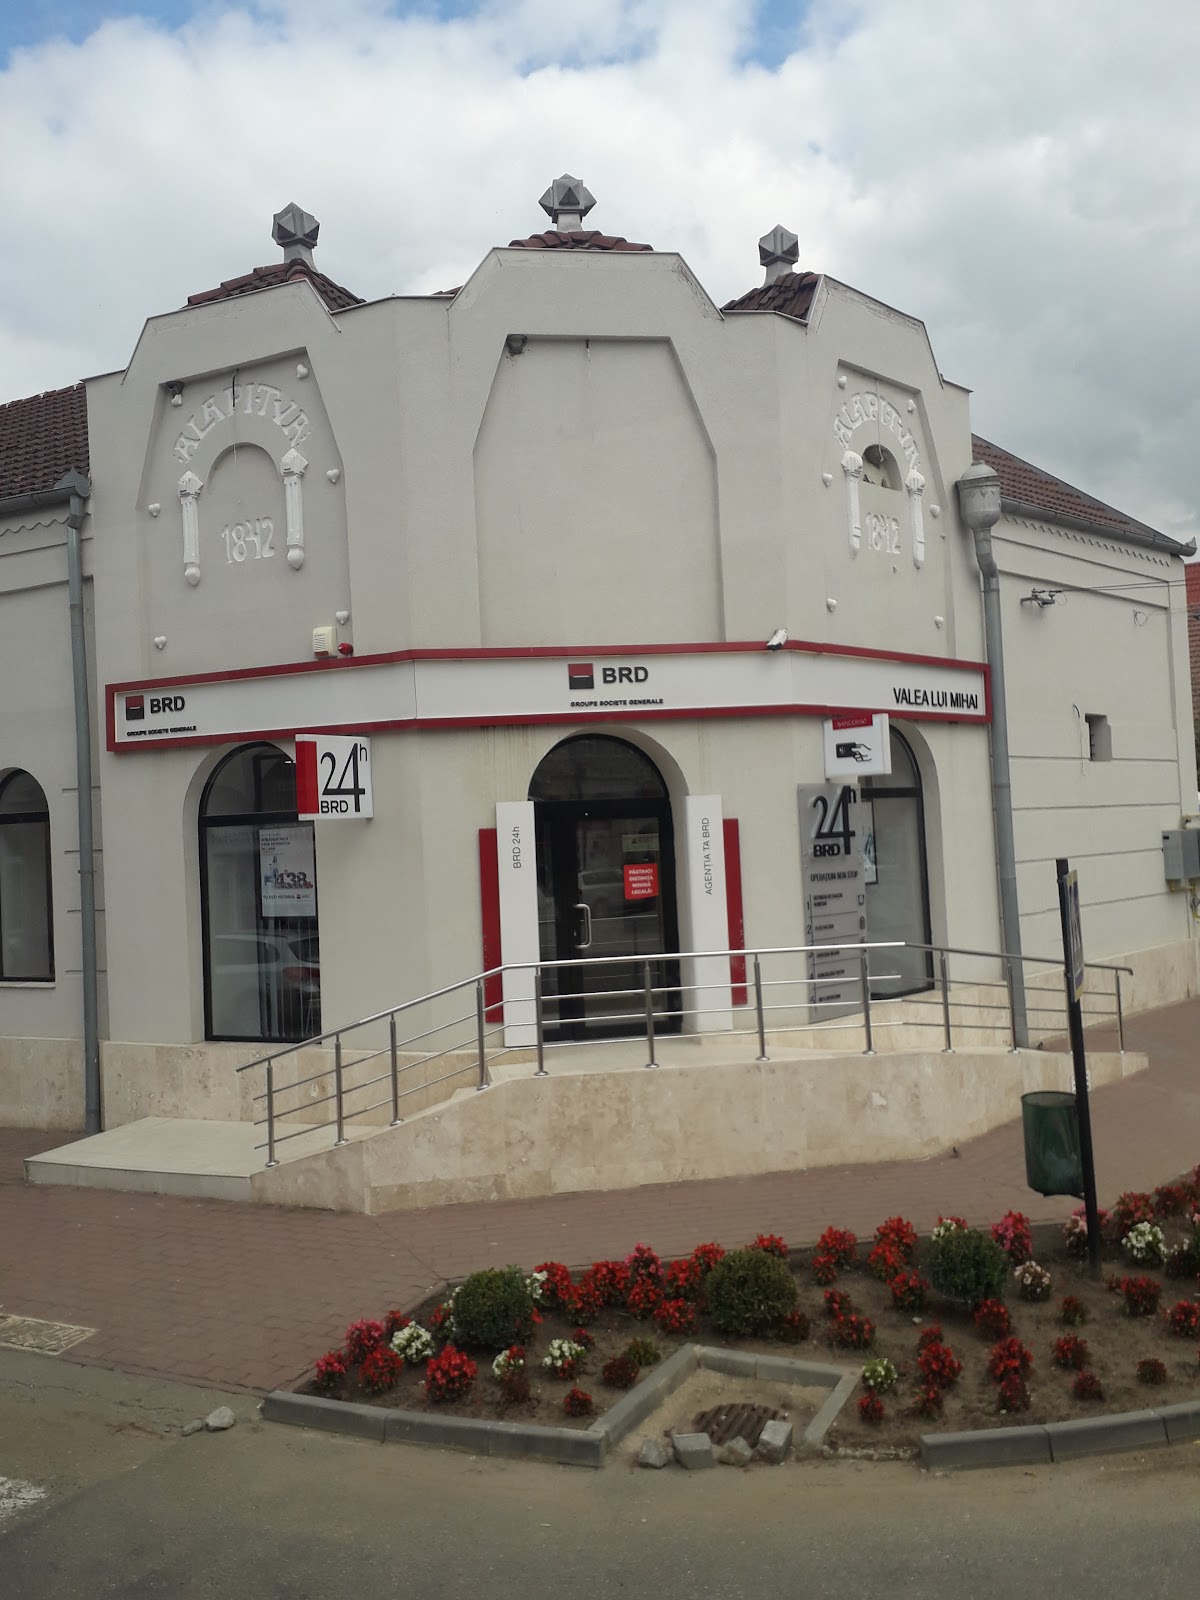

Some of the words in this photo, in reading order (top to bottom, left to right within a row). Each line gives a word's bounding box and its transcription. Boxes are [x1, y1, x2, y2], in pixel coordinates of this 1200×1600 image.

[221, 517, 275, 563] 1842
[866, 513, 901, 554] 1842
[602, 666, 649, 684] BRD
[150, 695, 185, 714] BRD
[893, 687, 930, 706] VALEA
[930, 690, 948, 707] LUI
[950, 692, 978, 709] MIHAI
[170, 725, 197, 733] GENERALE
[837, 718, 867, 727] BANCOMAT
[320, 800, 349, 814] BRD
[512, 826, 521, 844] 24h
[702, 817, 710, 838] BRD
[702, 840, 711, 852] TA
[813, 843, 840, 857] BRD
[513, 846, 521, 869] BRD
[837, 871, 847, 880] NON
[847, 870, 858, 879] STOP
